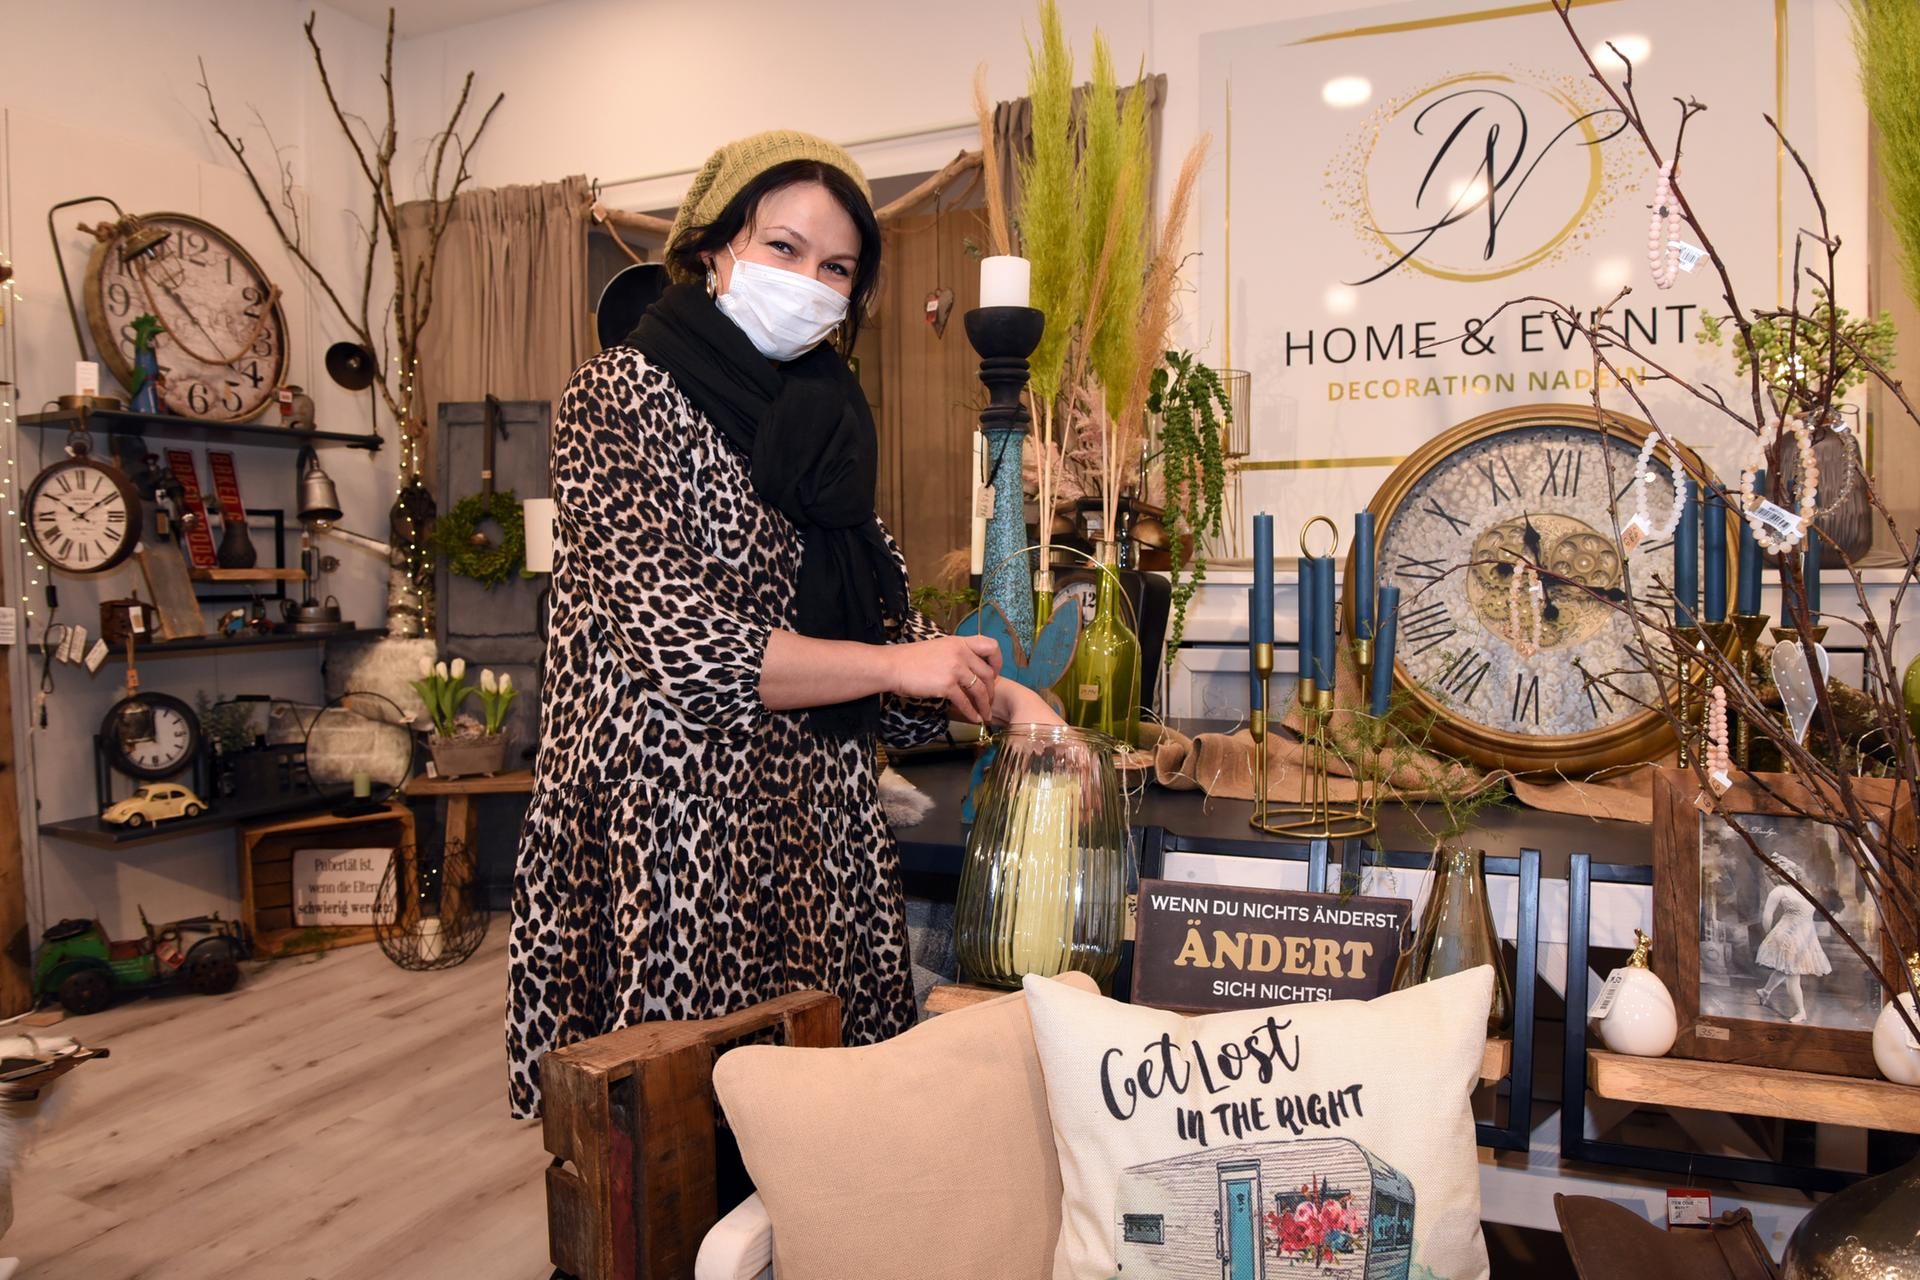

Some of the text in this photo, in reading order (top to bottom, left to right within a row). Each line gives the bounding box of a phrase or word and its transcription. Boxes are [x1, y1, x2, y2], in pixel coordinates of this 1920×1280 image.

[176, 229, 209, 268] 12
[108, 283, 131, 317] 9
[1286, 304, 1698, 367] HOME & EVENT
[241, 360, 265, 389] 4
[1327, 366, 1648, 401] DECORATION NADEIN
[188, 383, 209, 415] 6
[1082, 591, 1096, 608] 12
[308, 882, 336, 894] wenn
[337, 880, 352, 893] die
[298, 900, 348, 918] schwierig
[1150, 894, 1208, 914] WENN
[1213, 899, 1239, 916] DU
[1243, 903, 1310, 922] NICHTS
[1313, 906, 1400, 931] ÄNDERST,
[1174, 919, 1374, 980] ÄNDERT
[1212, 980, 1333, 1002] SICH NICHTS!
[1100, 1016, 1300, 1121] Get Lost
[1210, 1097, 1271, 1140] THE
[1276, 1083, 1364, 1136] RIGHT
